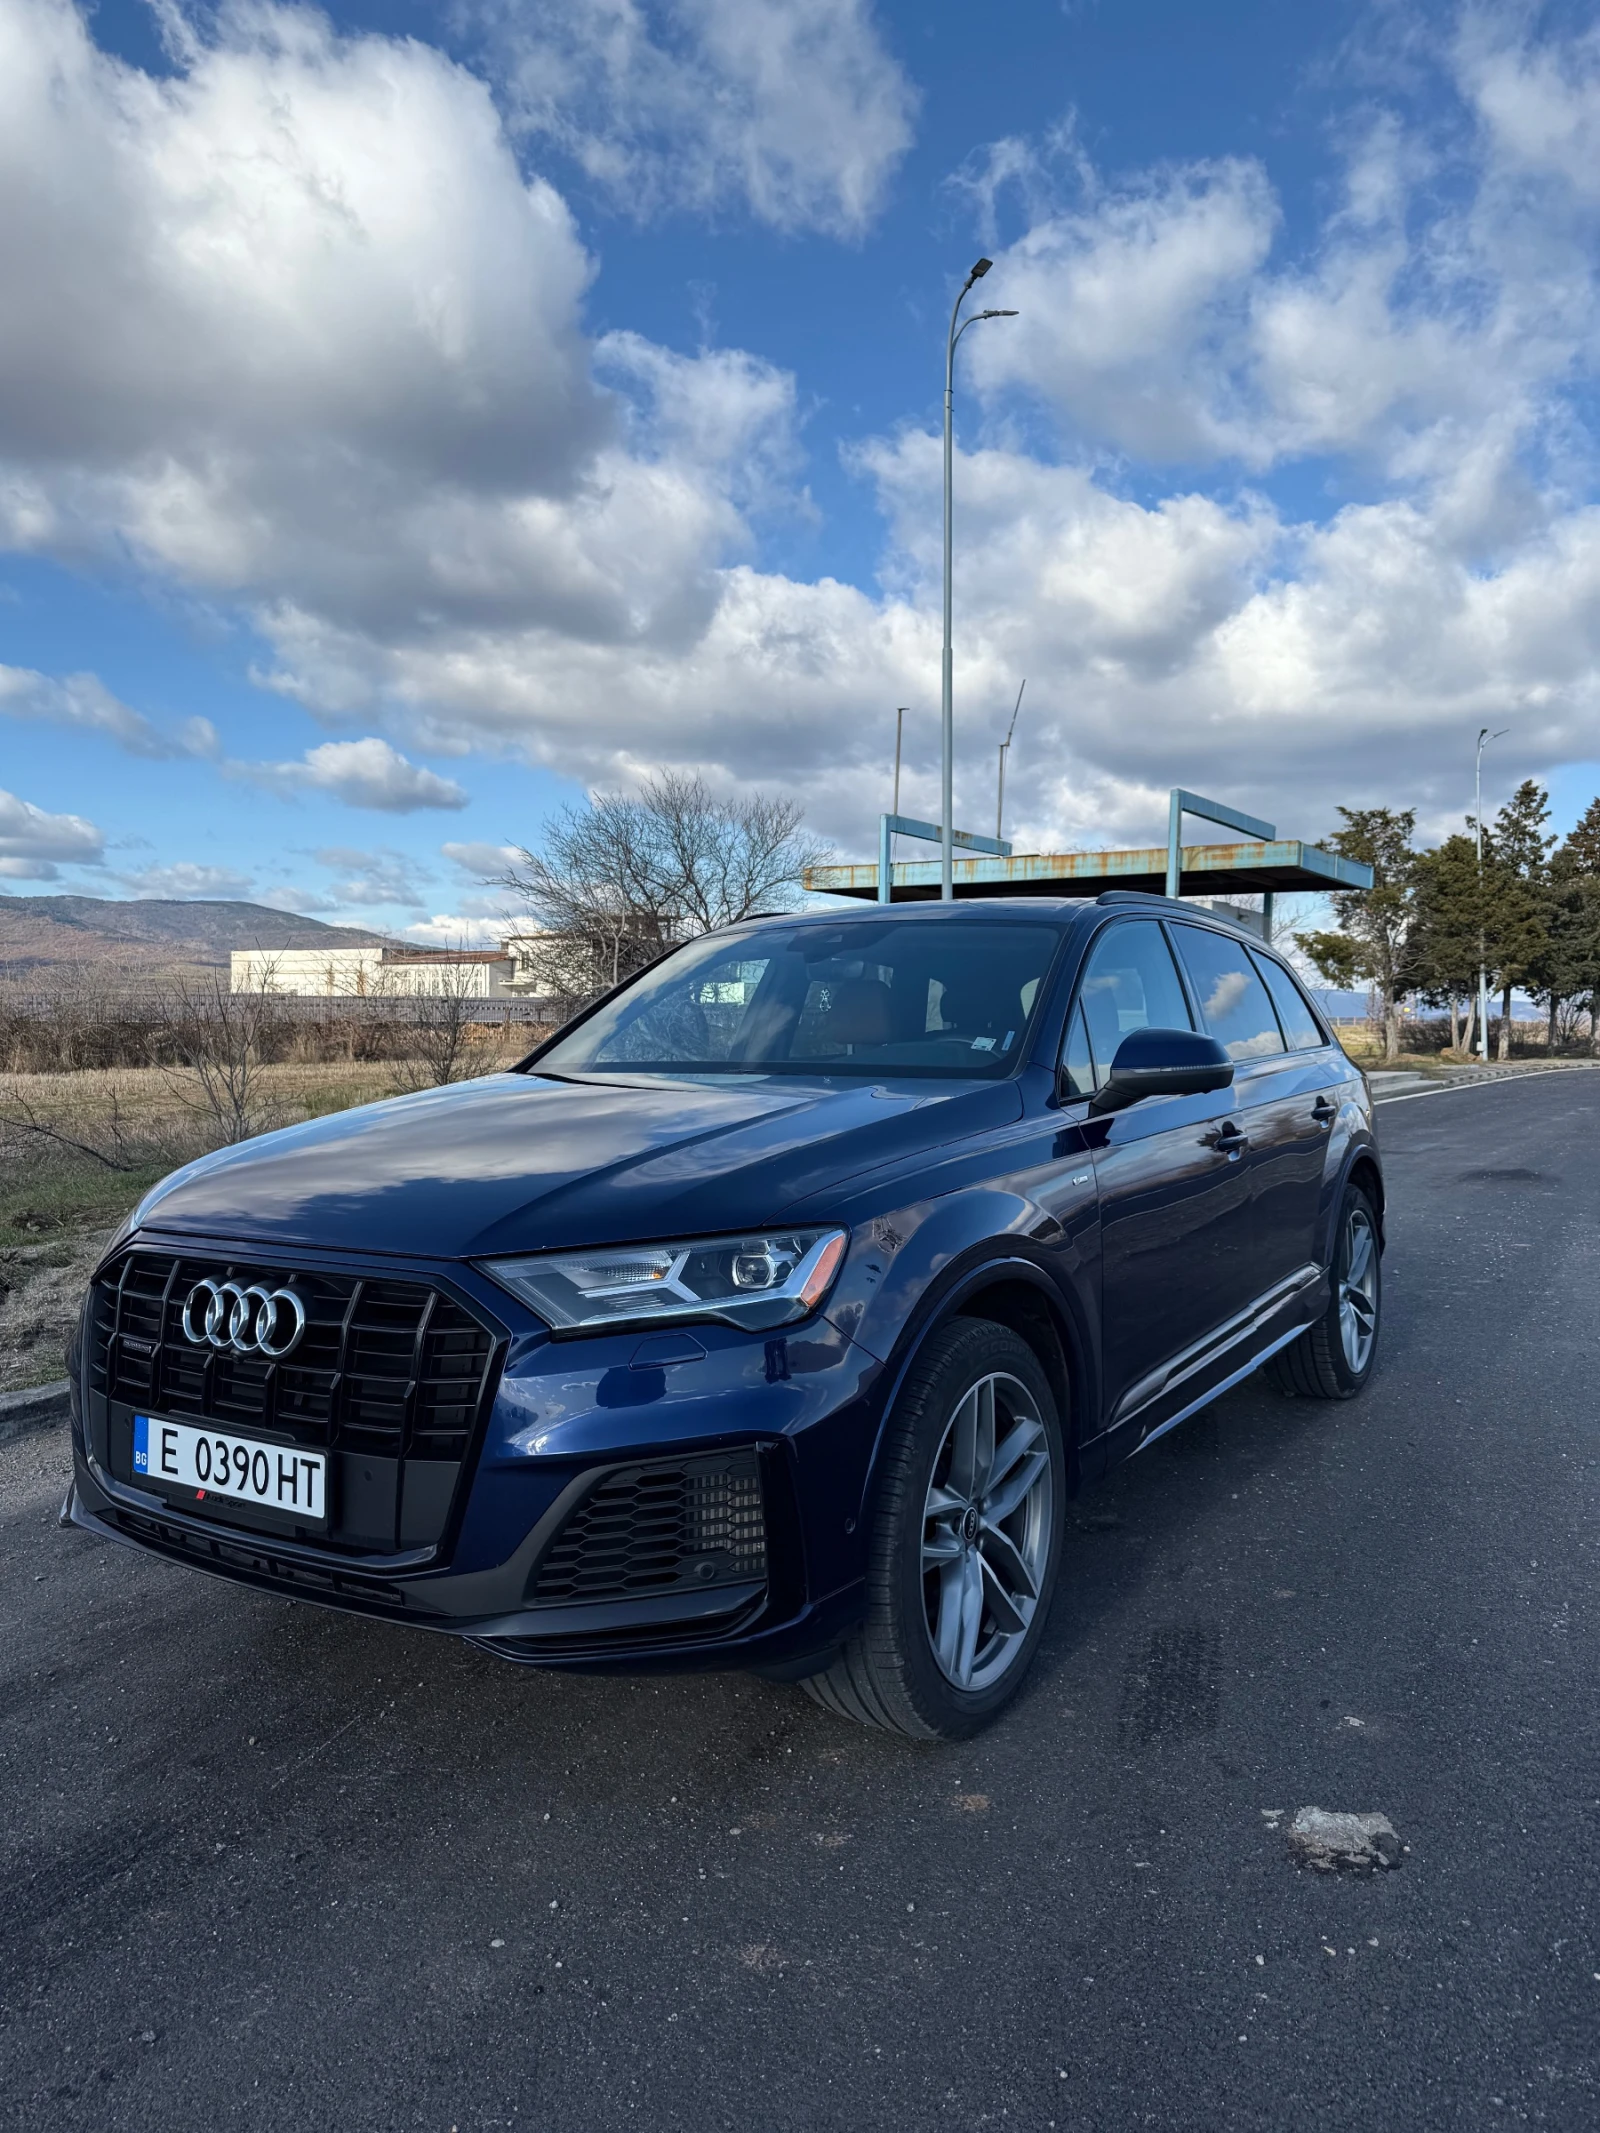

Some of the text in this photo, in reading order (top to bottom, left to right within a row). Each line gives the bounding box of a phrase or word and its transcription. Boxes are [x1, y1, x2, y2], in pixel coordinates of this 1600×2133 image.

[135, 1450, 147, 1466] BG
[161, 1427, 321, 1508] E 0390 HT
